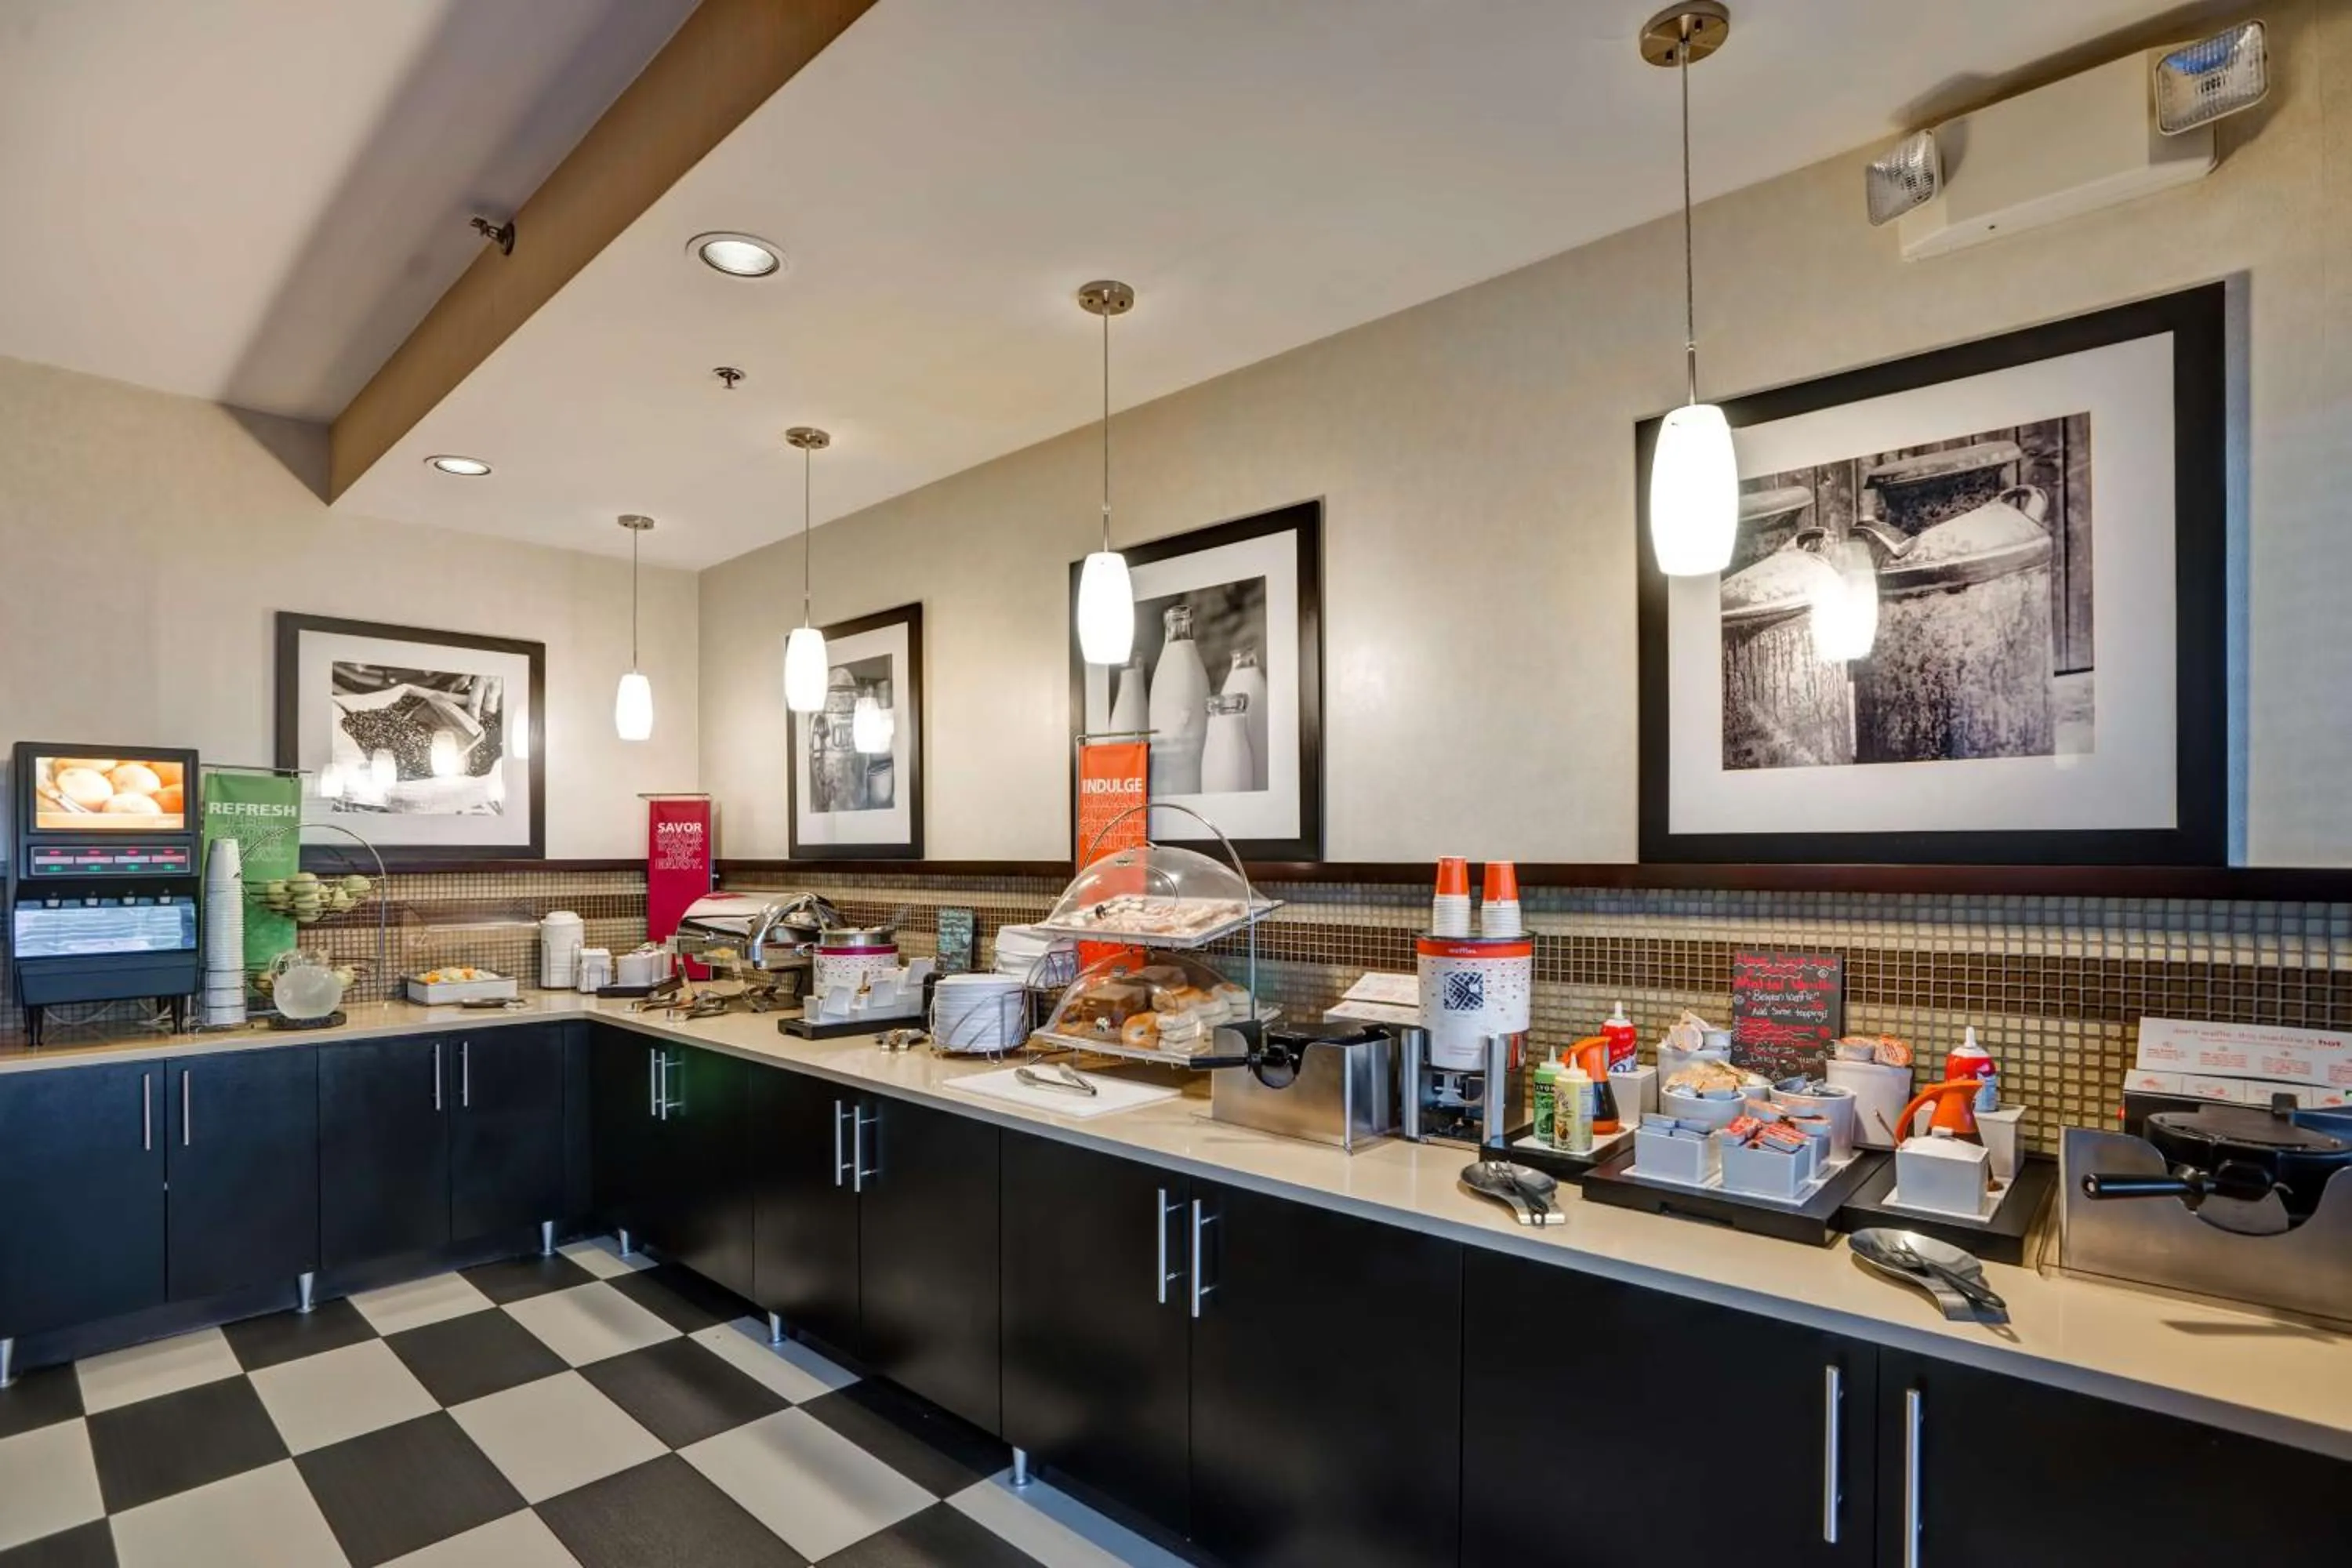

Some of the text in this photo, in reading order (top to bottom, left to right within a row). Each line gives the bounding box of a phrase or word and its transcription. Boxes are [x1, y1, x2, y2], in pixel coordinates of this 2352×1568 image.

[1083, 778, 1142, 793] INDULGE
[209, 802, 297, 817] REFRESH
[658, 822, 702, 833] SAVOR
